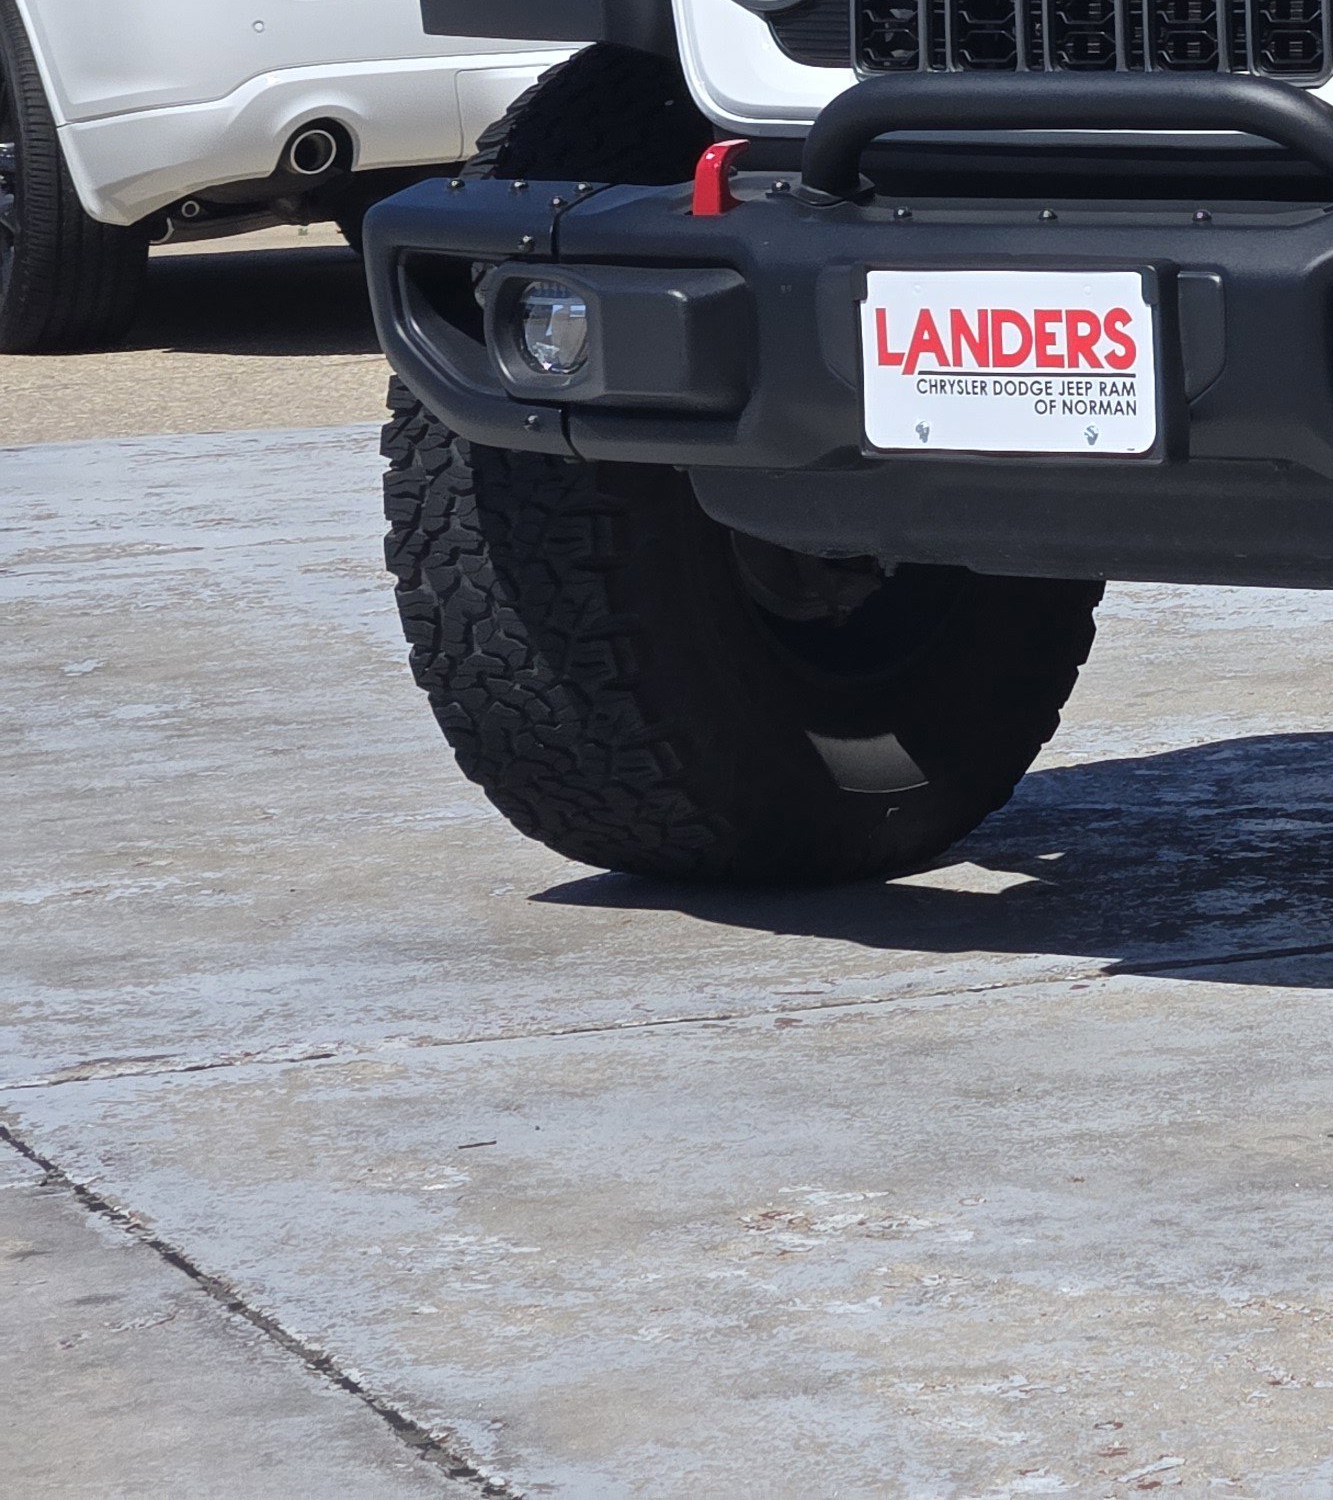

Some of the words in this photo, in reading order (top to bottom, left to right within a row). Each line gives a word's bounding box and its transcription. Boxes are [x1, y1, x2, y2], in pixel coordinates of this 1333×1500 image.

[874, 307, 1138, 376] LANDERS
[916, 378, 989, 397] CHRYSLER
[992, 379, 1054, 398] DODGE
[1057, 380, 1094, 398] JEEP
[1098, 380, 1137, 398] RAM
[1033, 398, 1058, 416] OF
[1061, 398, 1138, 417] NORMAN
